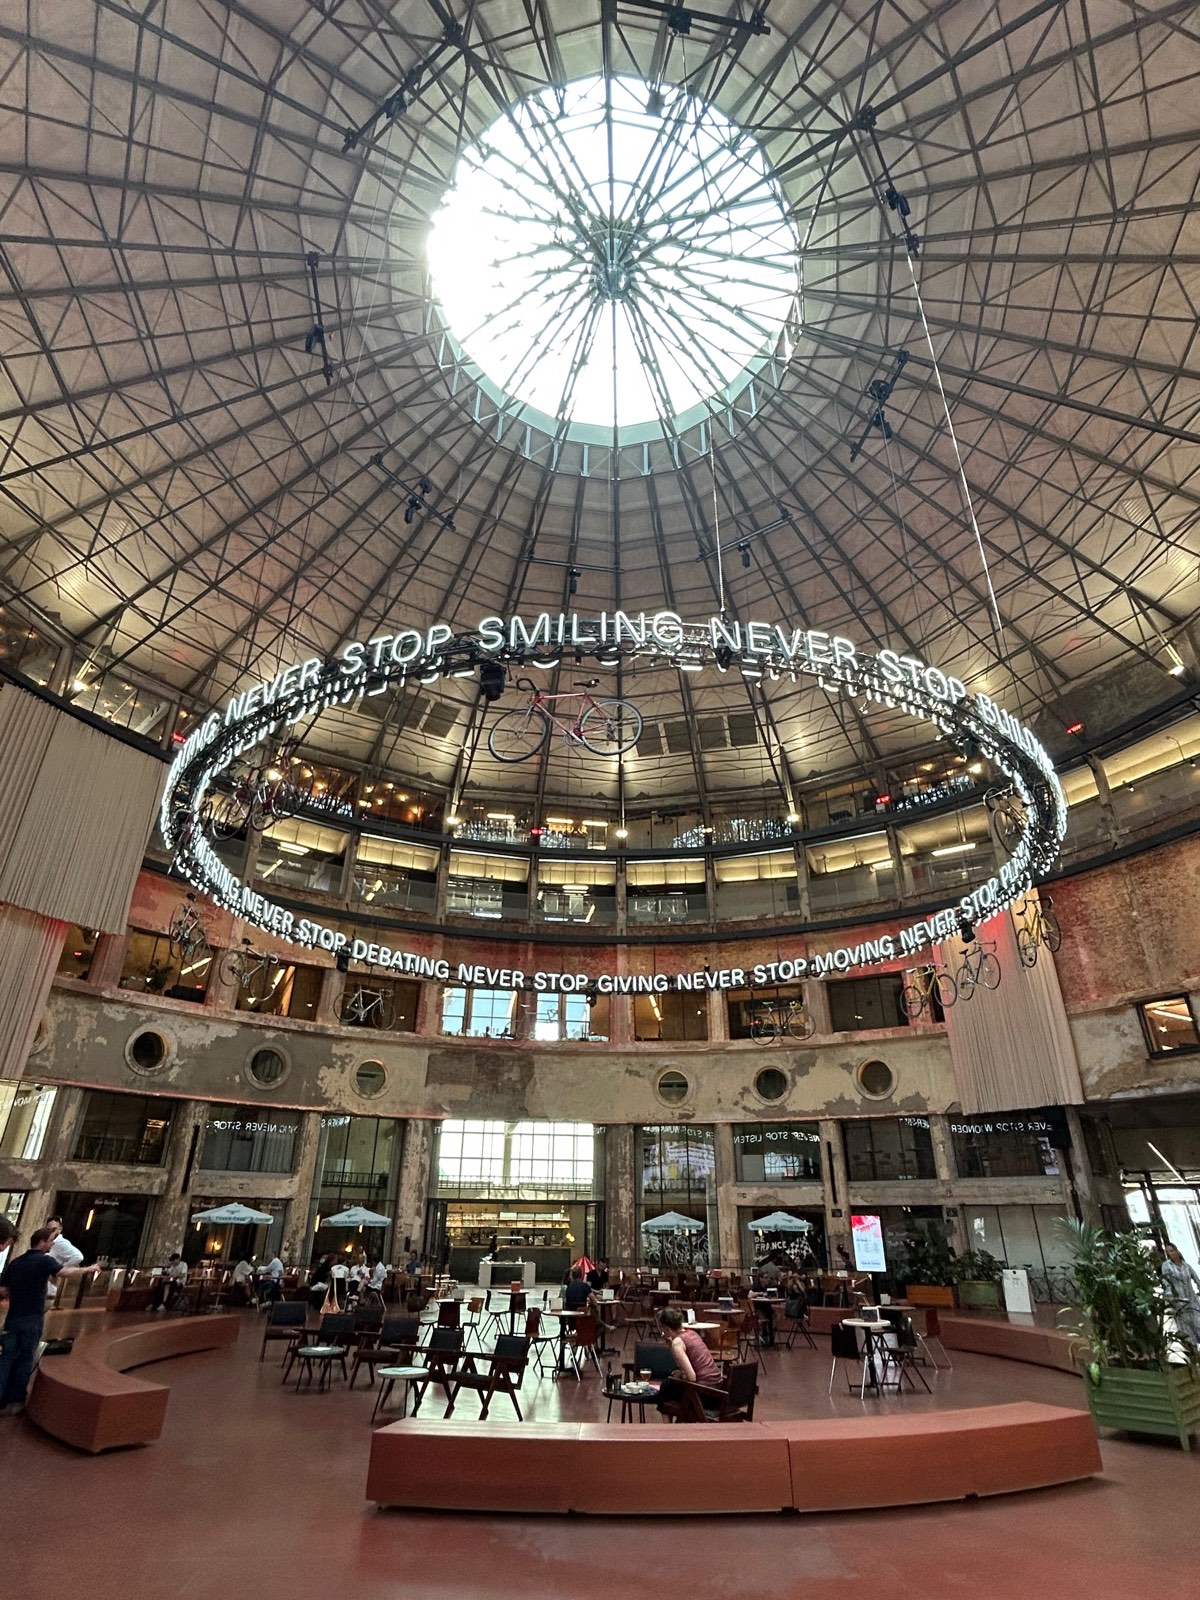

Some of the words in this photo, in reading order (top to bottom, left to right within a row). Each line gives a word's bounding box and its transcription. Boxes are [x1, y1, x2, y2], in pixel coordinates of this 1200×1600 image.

[224, 658, 322, 726] NEVER
[340, 624, 453, 675] STOP
[478, 610, 684, 650] SMILING
[709, 617, 859, 670] NEVER
[879, 649, 967, 705] STOP
[242, 886, 294, 933] NEVER
[299, 918, 347, 951] STOP
[353, 939, 450, 980] DEBATING
[458, 963, 524, 988] NEVER
[534, 971, 588, 992] STOP
[598, 974, 668, 993] GIVING
[677, 968, 745, 991] NEVER
[753, 959, 807, 985] STOP
[815, 934, 893, 972] MOVING
[900, 907, 957, 948] NEVER
[960, 877, 999, 919] STOP
[755, 1241, 787, 1252] FRANCE
